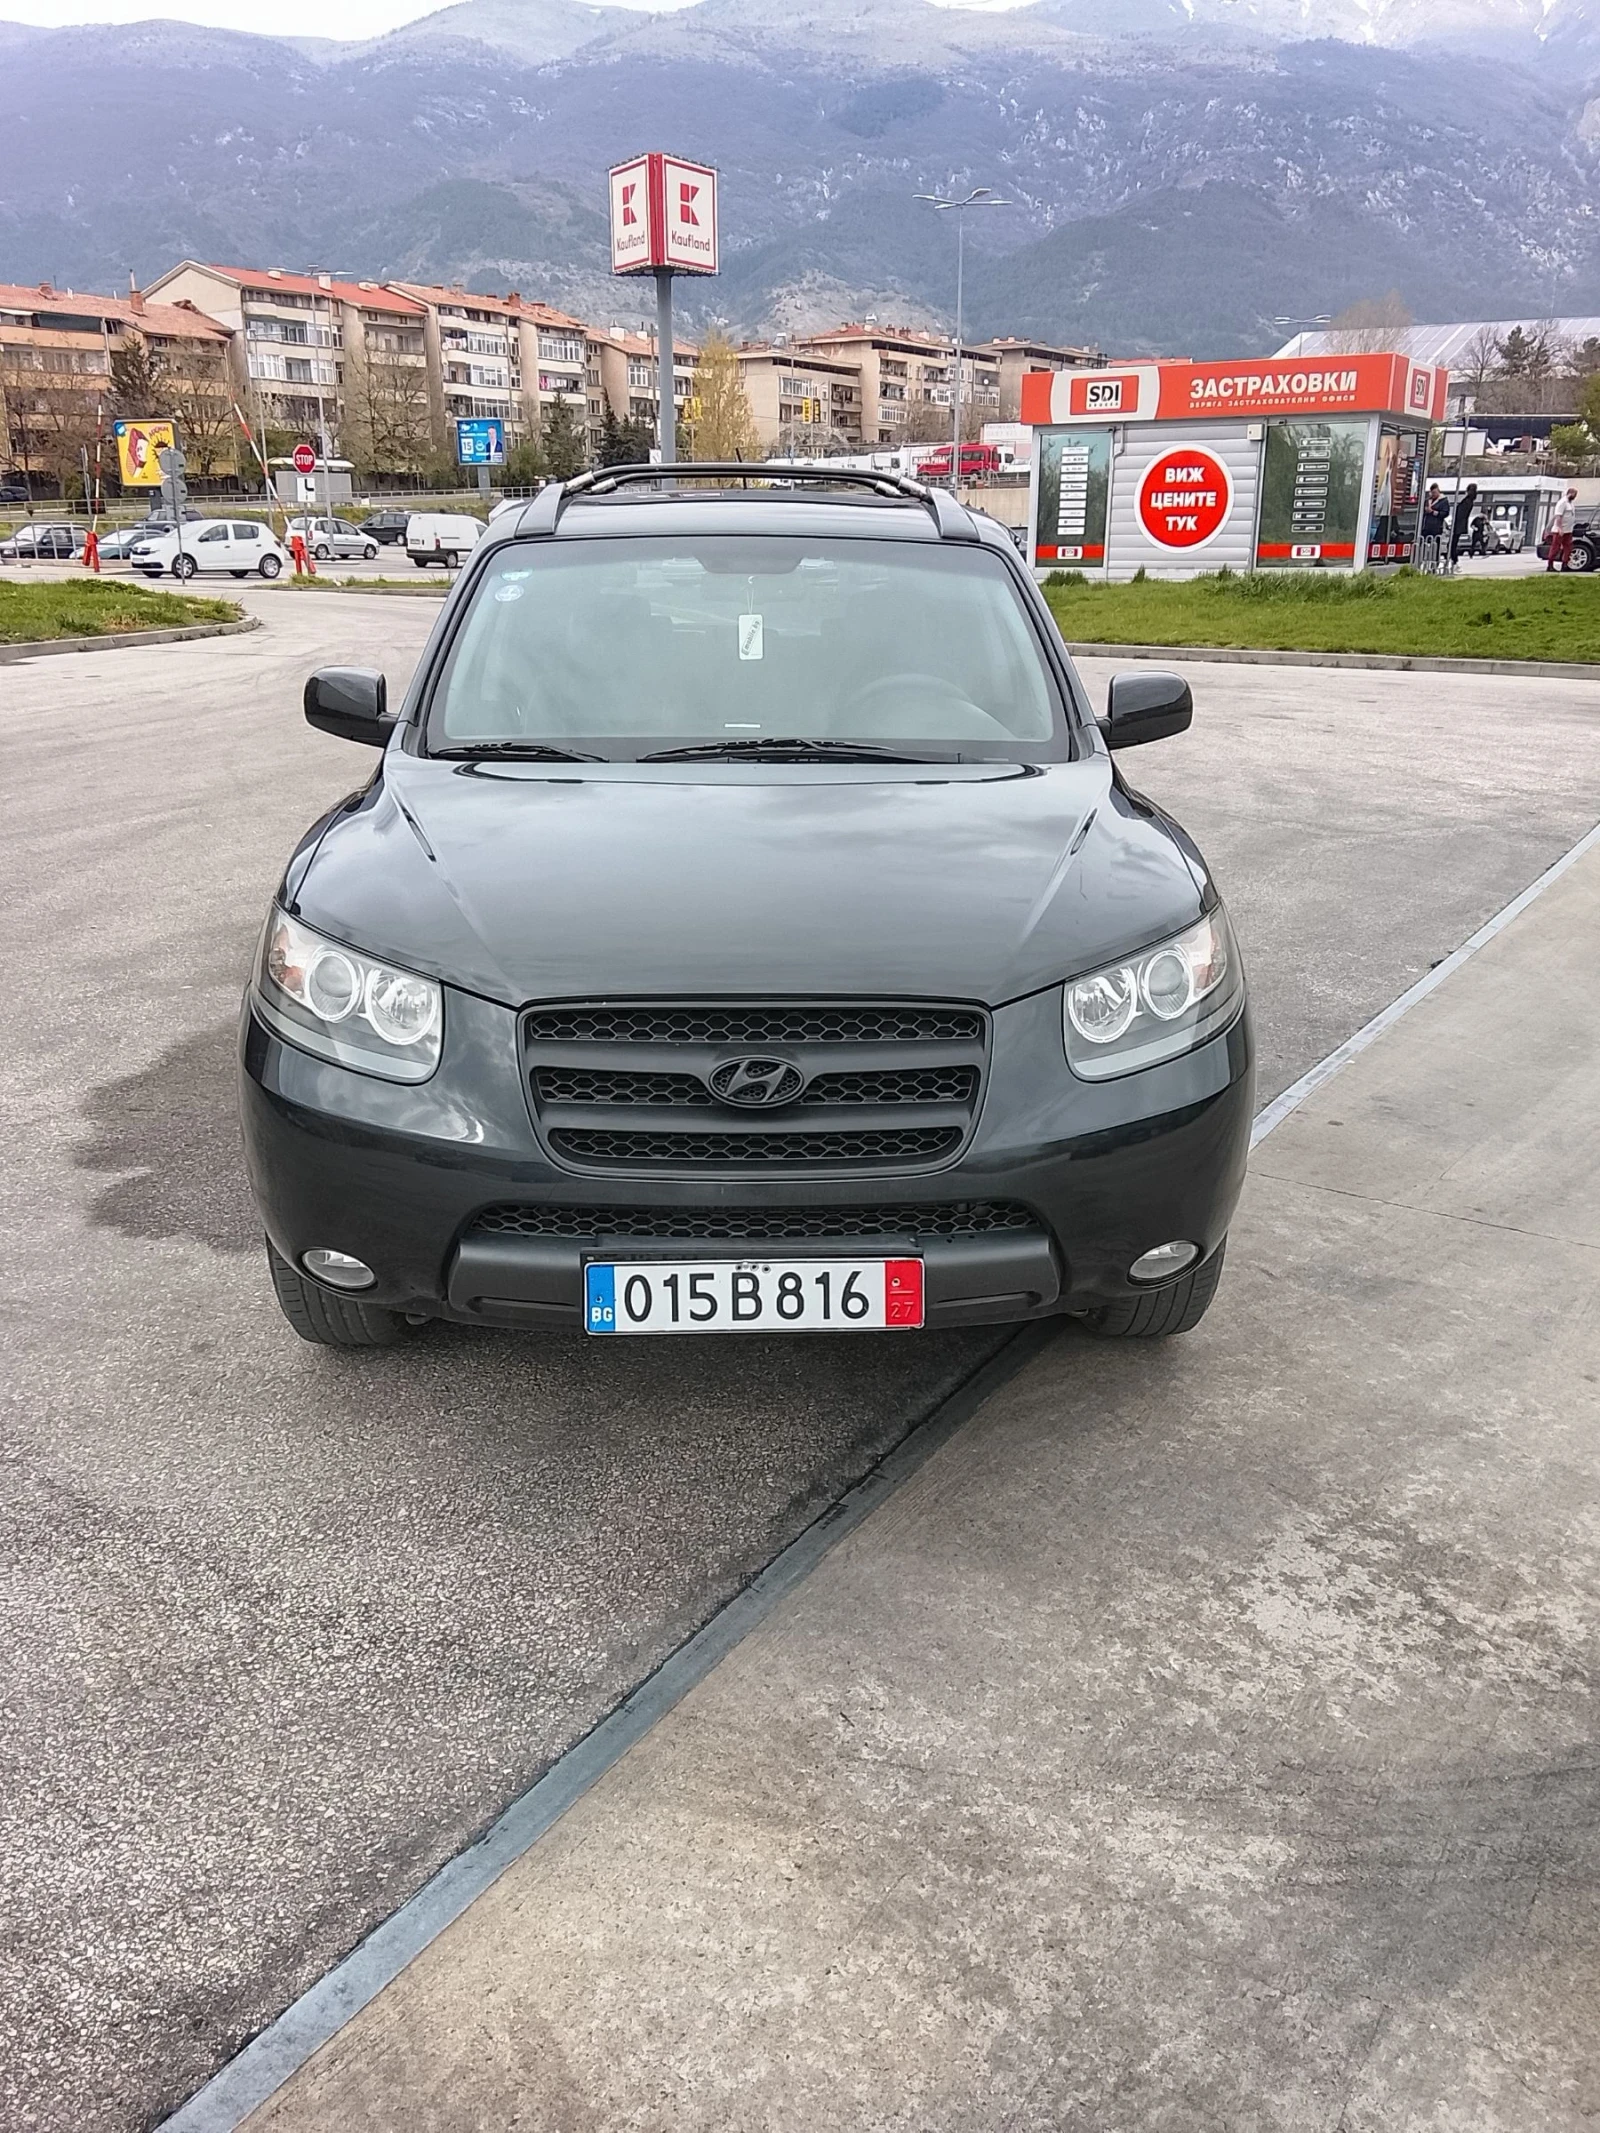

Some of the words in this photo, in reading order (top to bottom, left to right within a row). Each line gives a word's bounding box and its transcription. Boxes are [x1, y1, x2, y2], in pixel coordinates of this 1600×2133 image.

[617, 230, 645, 252] Kaufland
[671, 230, 710, 252] Kaufland
[1089, 384, 1120, 402] SDI
[1189, 371, 1358, 399] ЗАСТРАХОВКИ
[1322, 394, 1356, 403] ОФИСИ
[296, 454, 314, 465] STOP
[1164, 467, 1205, 484] ВИЖ
[1150, 491, 1218, 511] ЦЕНИТЕ
[1165, 515, 1198, 531] ТУК
[591, 1307, 613, 1322] BG
[624, 1271, 870, 1322] 015B816
[890, 1302, 914, 1319] 27
